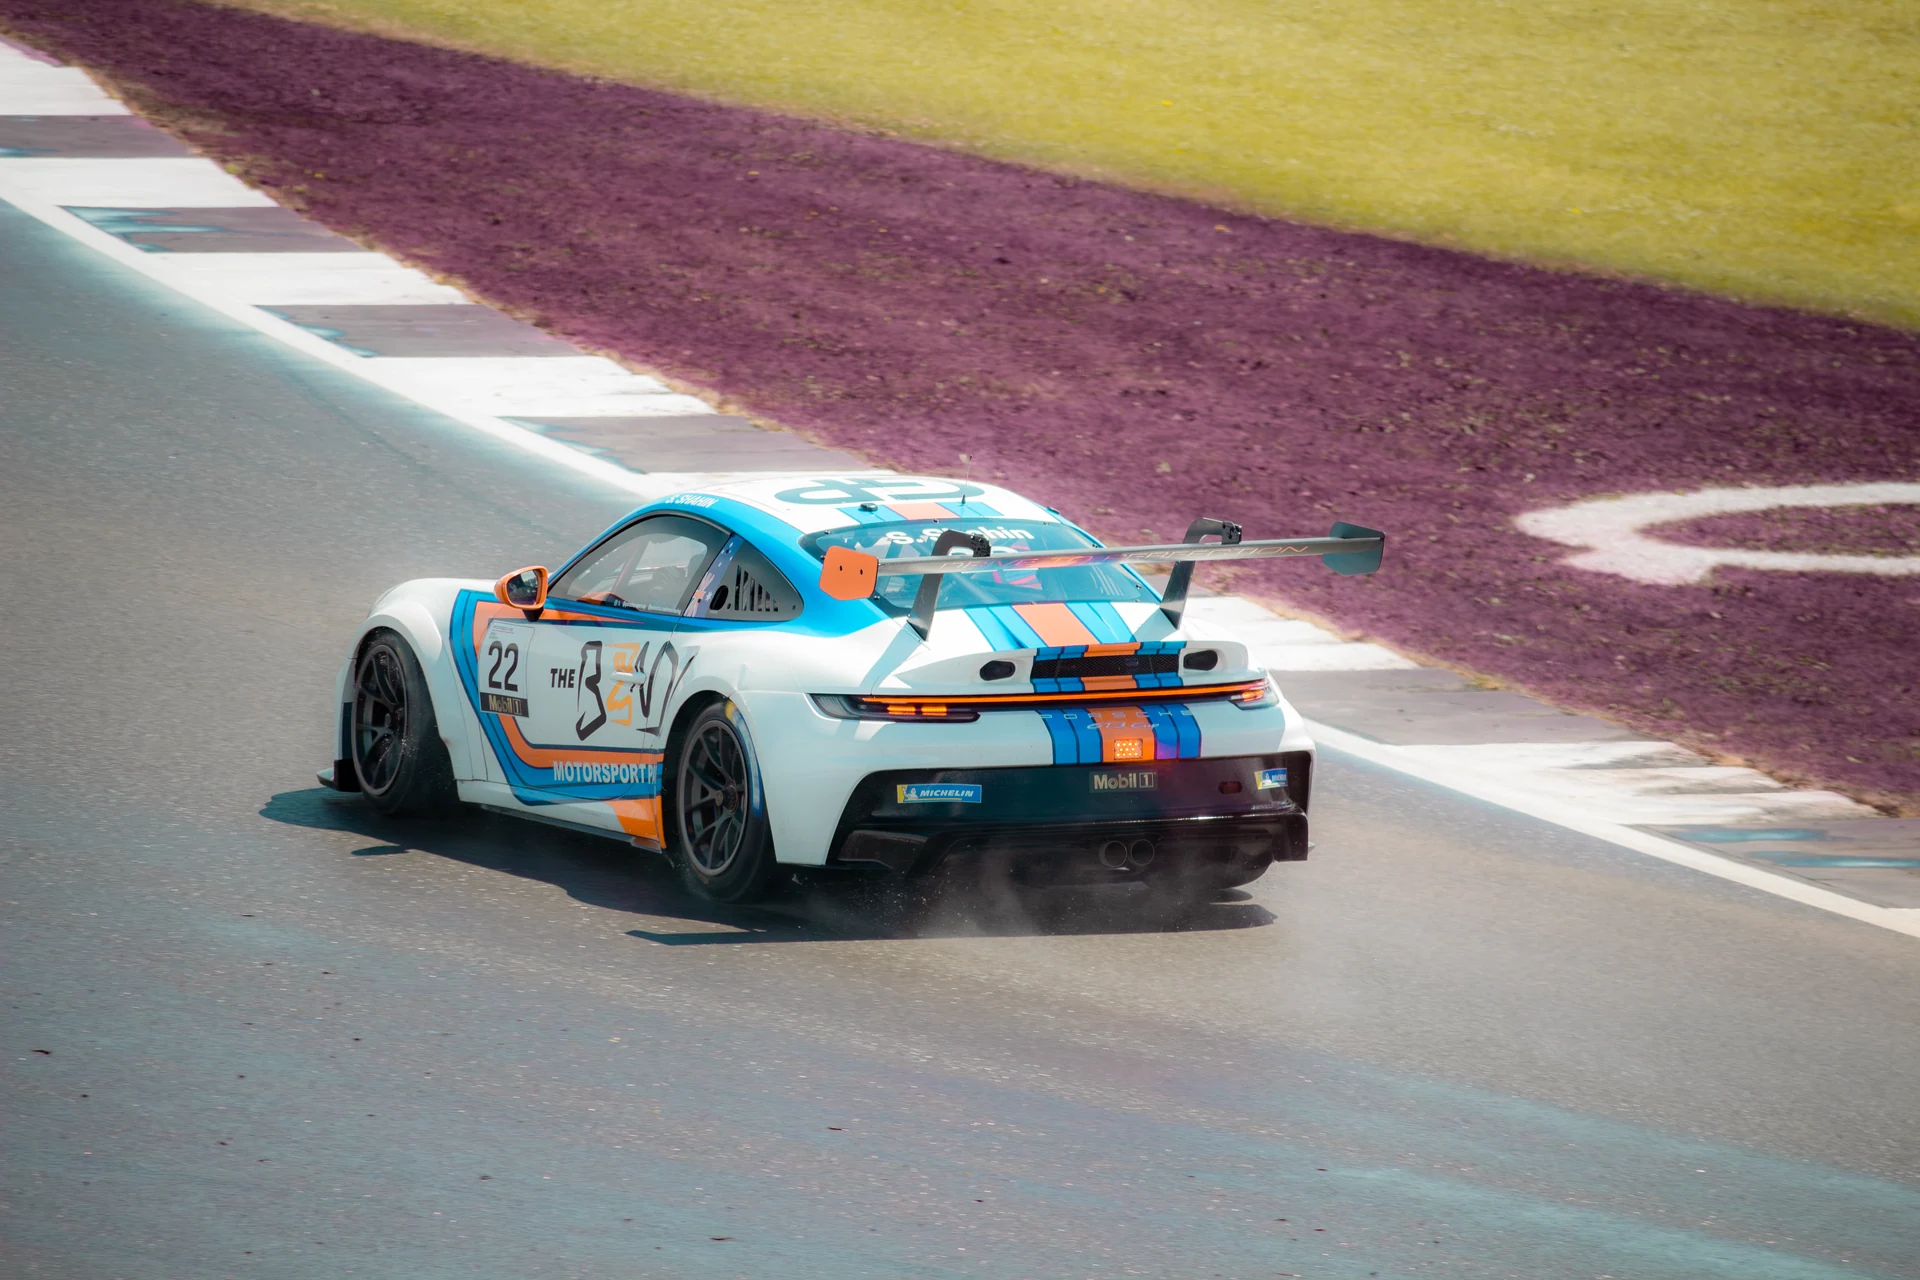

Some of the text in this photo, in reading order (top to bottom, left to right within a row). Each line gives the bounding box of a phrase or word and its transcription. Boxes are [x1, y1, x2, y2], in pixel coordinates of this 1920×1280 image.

[1102, 545, 1309, 562] PERFECTION
[488, 640, 519, 692] 22
[550, 668, 576, 689] THE
[488, 694, 513, 714] Mobil
[1039, 709, 1196, 720] PORSCHE
[1087, 721, 1160, 731] GT3 Cup
[553, 760, 646, 784] MOTORSPORT
[1093, 773, 1137, 790] Mobil
[919, 789, 974, 797] MICHELIN
